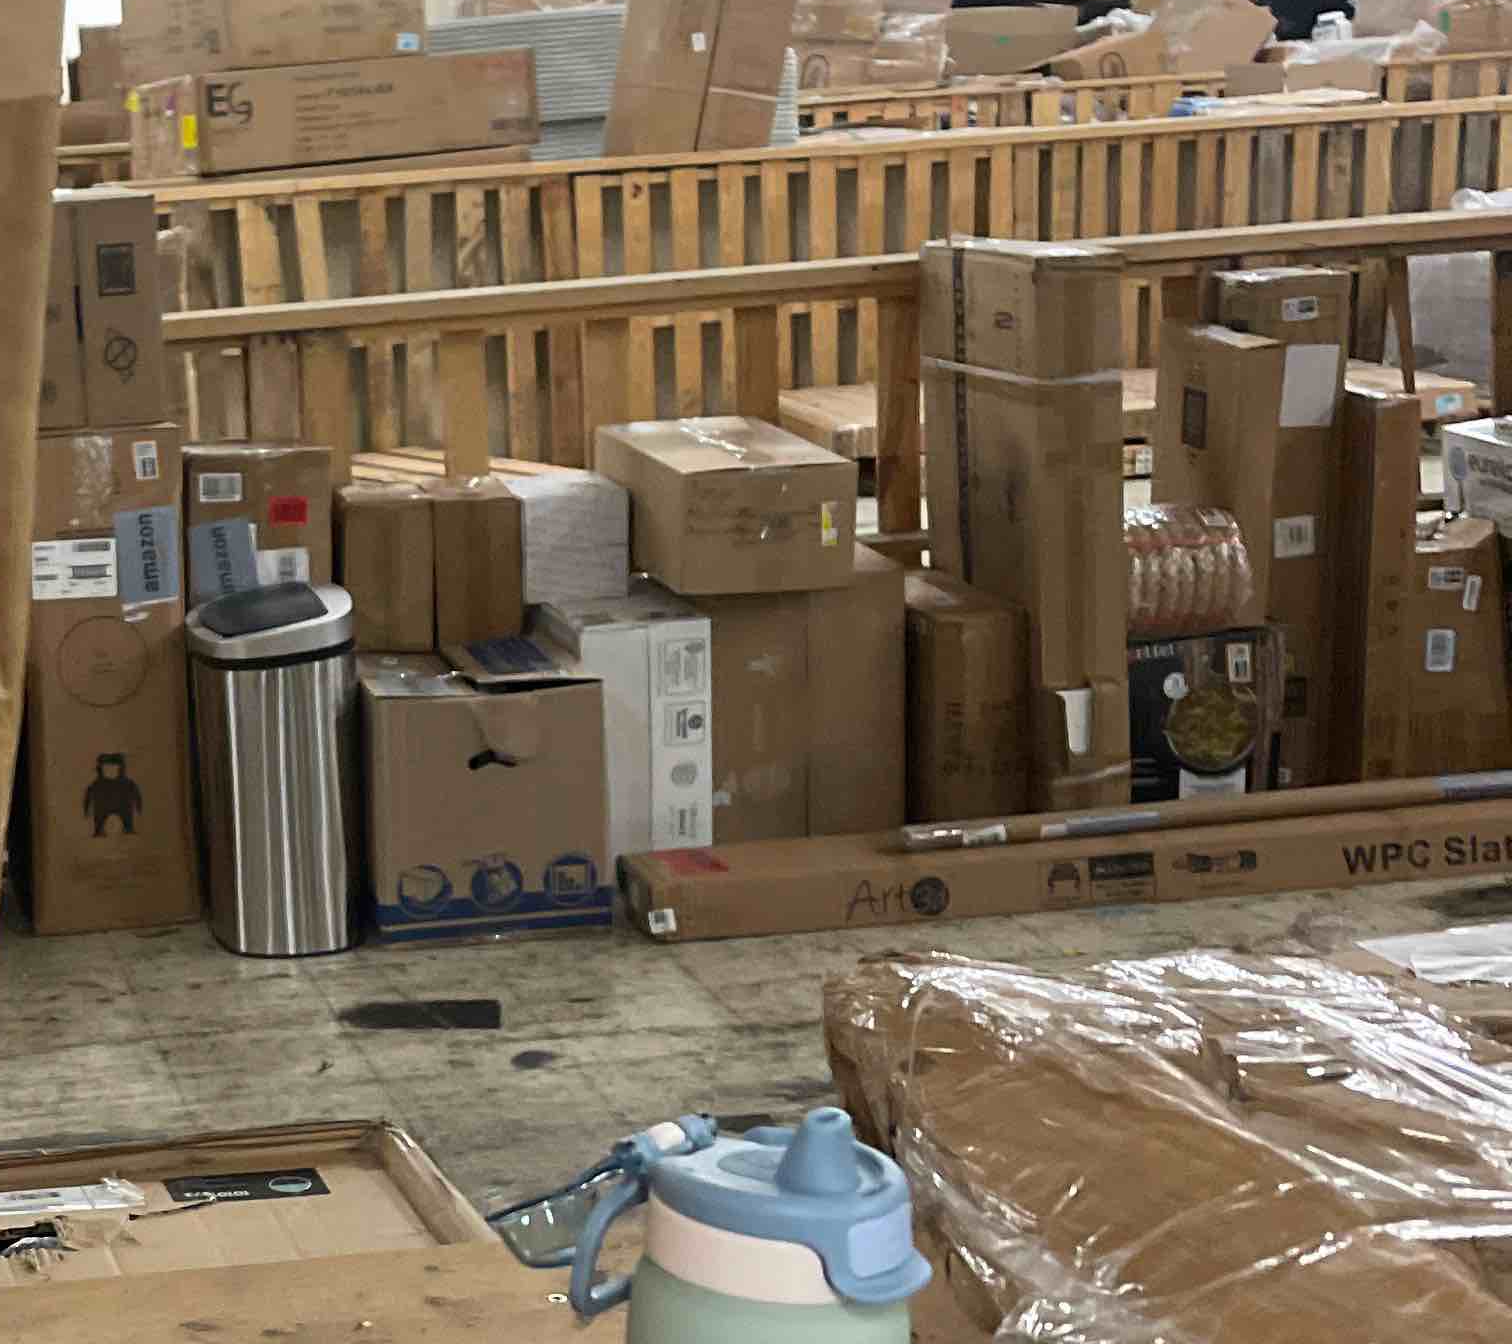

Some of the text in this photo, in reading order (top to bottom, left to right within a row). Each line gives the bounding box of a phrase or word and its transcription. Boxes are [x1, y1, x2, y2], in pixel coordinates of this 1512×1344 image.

[138, 512, 161, 593] amazon
[211, 525, 235, 593] mazon
[1342, 839, 1431, 876] WPC
